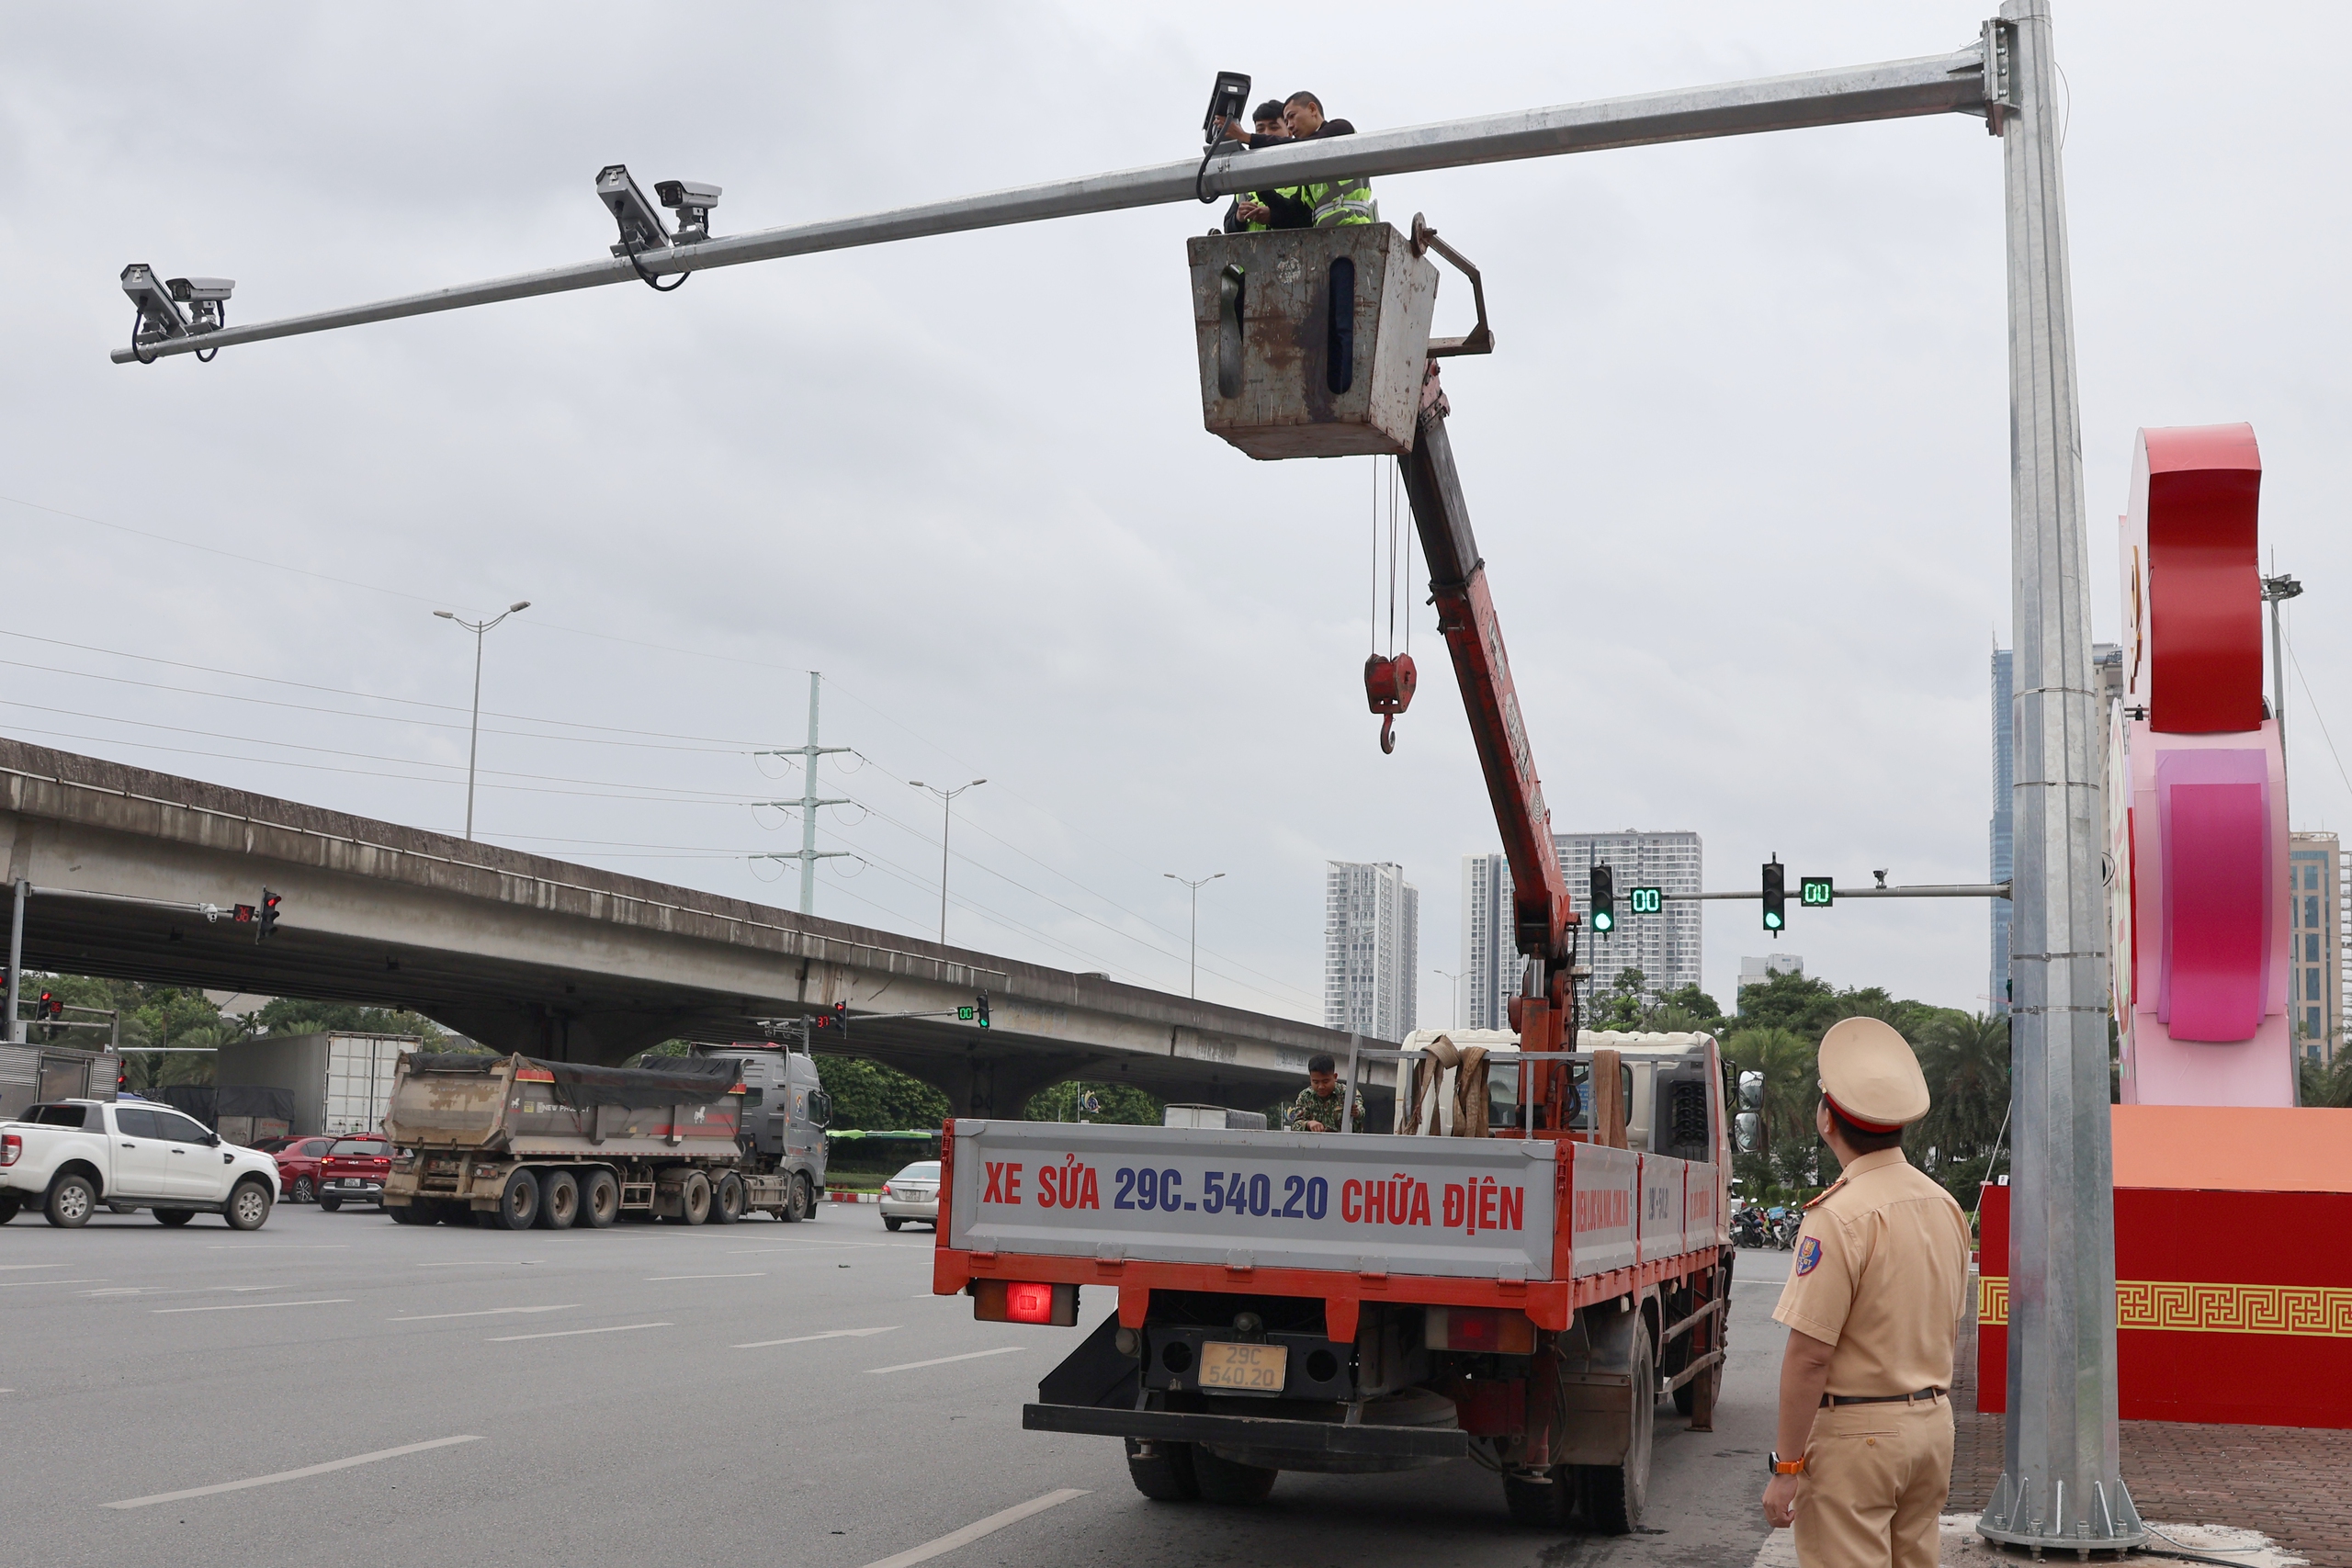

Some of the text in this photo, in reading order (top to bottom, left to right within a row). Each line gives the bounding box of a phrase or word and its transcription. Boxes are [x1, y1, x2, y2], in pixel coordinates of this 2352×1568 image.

[1633, 889, 1659, 912] 00
[818, 1015, 830, 1028] 37
[959, 1008, 972, 1019] 00
[983, 1162, 1023, 1204] XE
[1037, 1153, 1100, 1210] SỬA
[1341, 1172, 1431, 1226] CHỮA
[1226, 1347, 1261, 1365] 29C
[1209, 1366, 1275, 1386] 540.20
